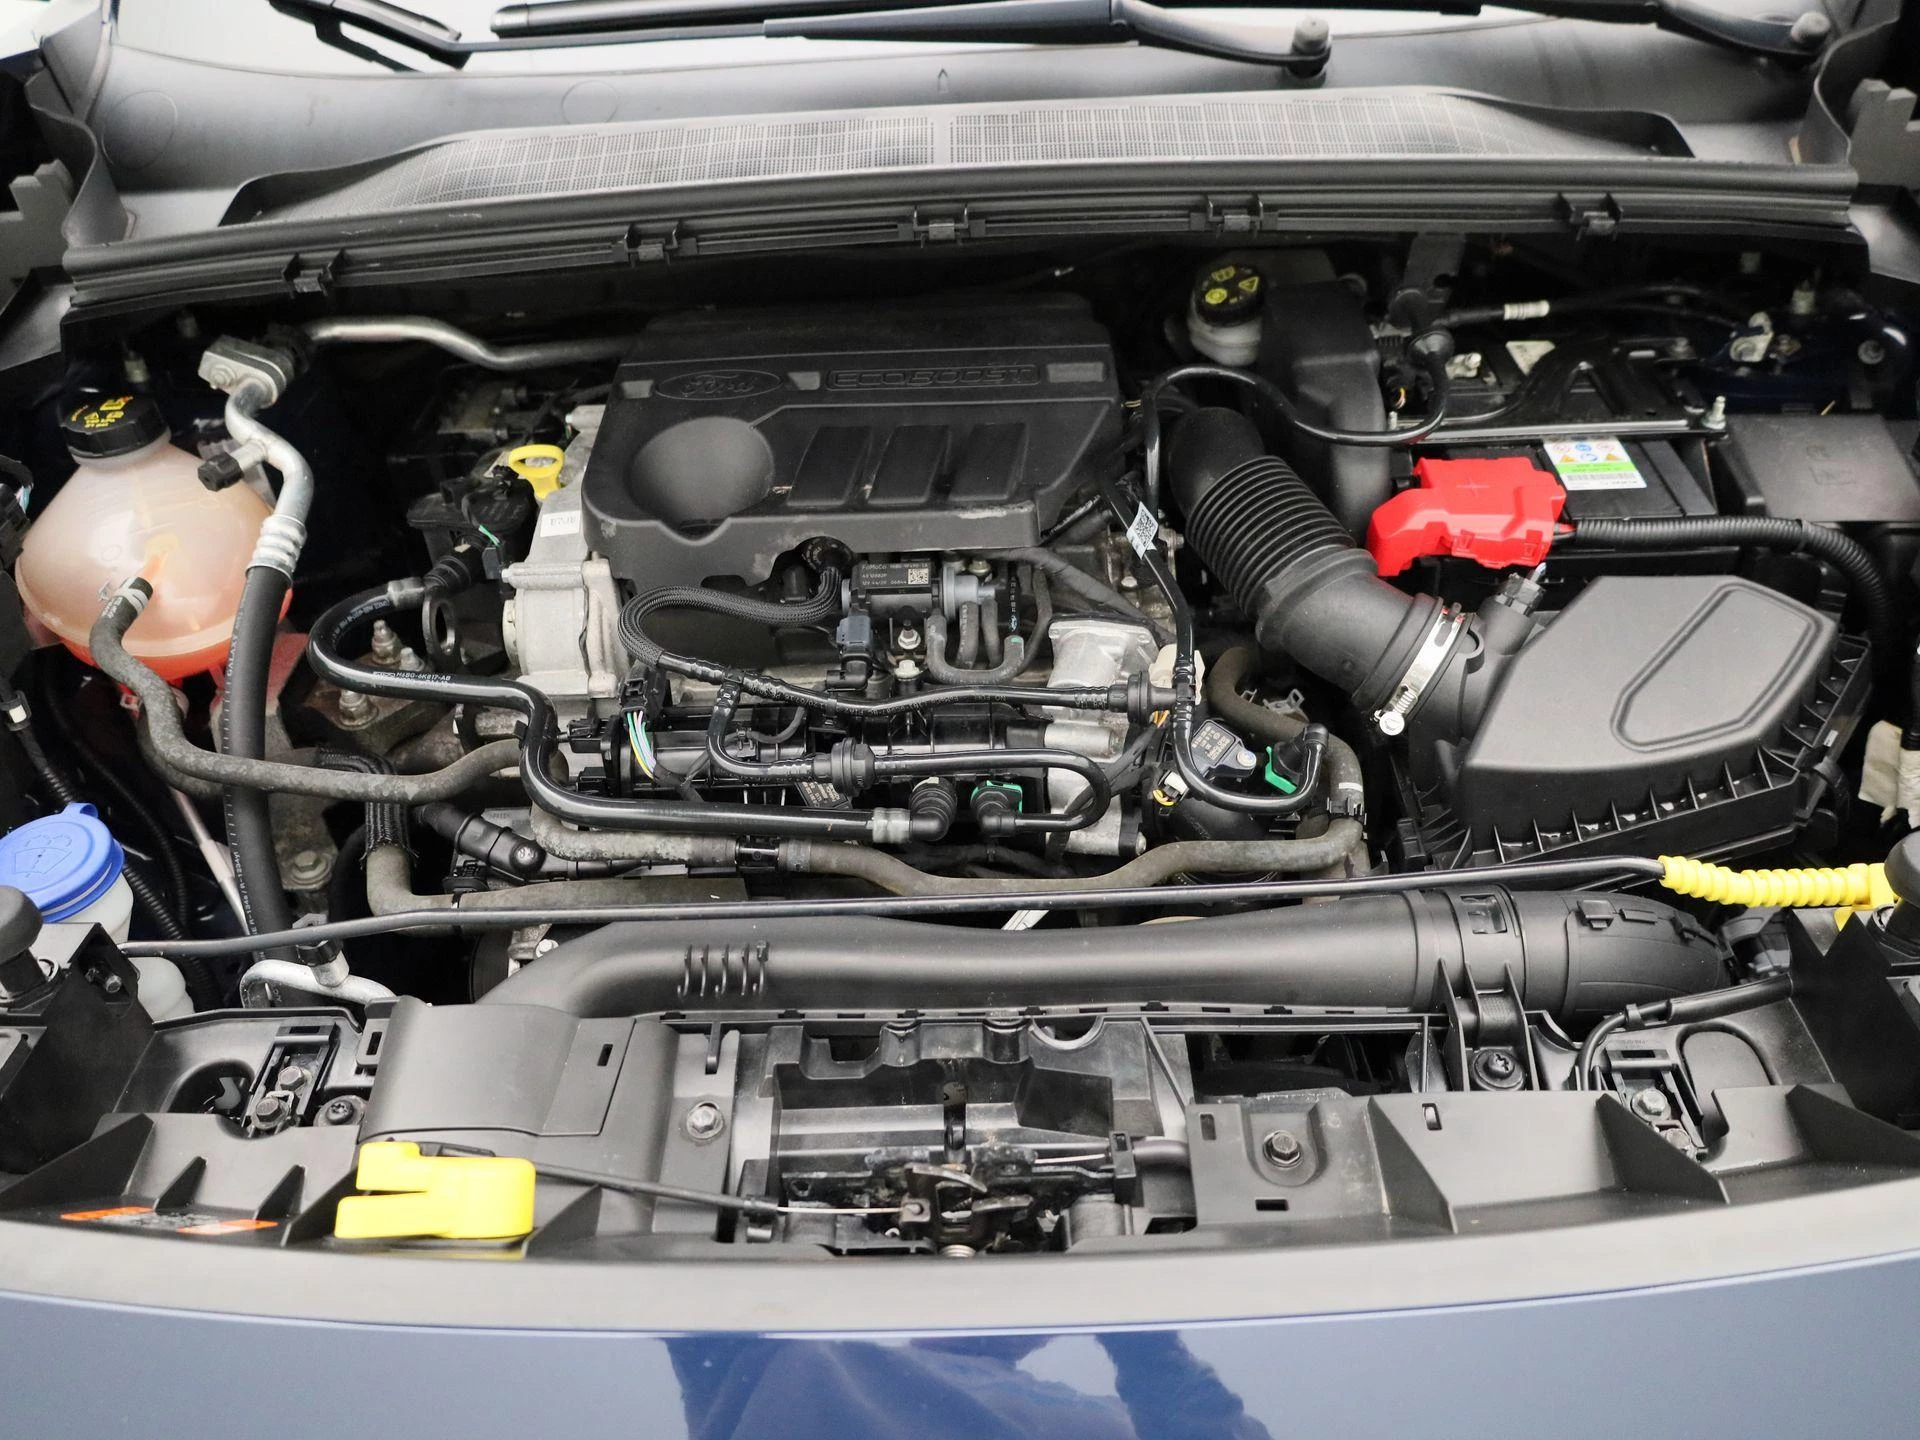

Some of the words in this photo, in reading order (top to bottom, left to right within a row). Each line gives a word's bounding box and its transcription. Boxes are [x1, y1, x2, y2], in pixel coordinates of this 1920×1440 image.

[680, 373, 758, 397] Ford
[835, 368, 1034, 388] ECOBOOST
[226, 634, 237, 677] GALAXY
